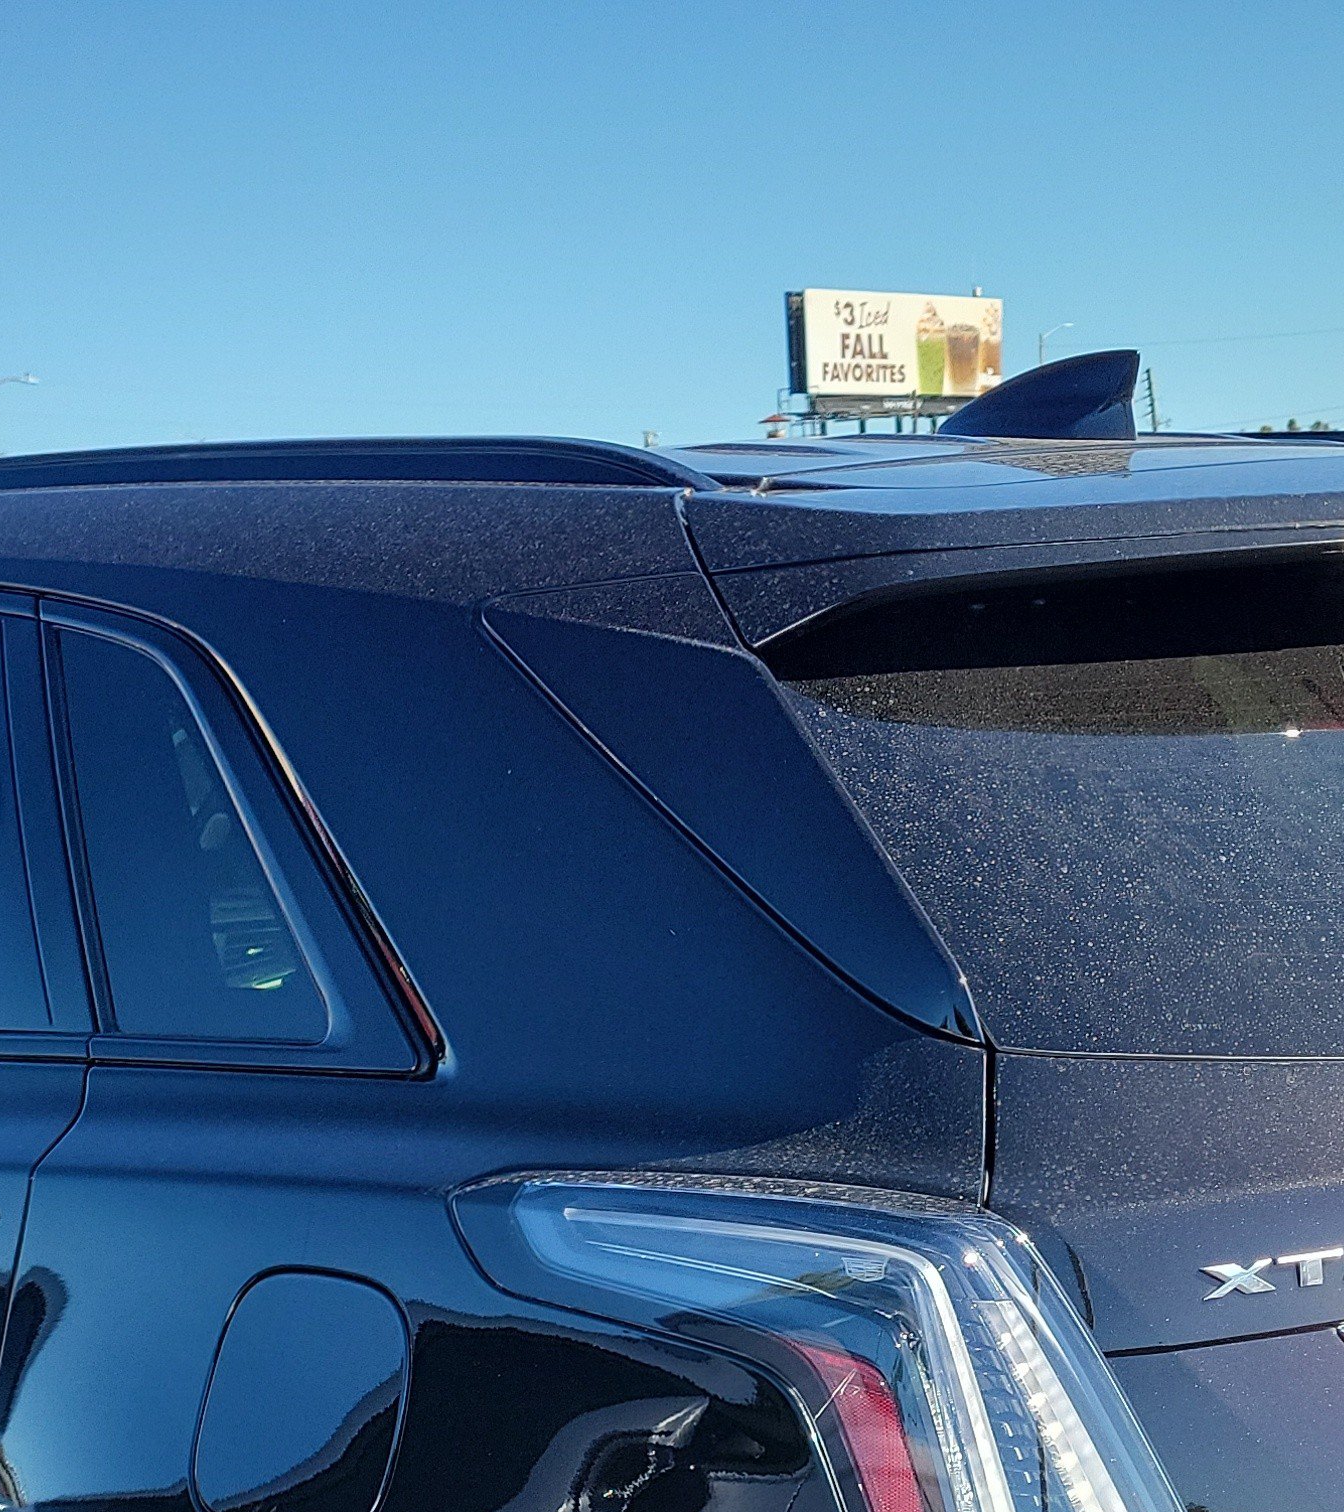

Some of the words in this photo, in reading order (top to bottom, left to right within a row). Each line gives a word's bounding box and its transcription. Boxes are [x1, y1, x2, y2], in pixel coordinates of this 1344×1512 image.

[834, 300, 855, 326] $3
[858, 301, 891, 329] Iced
[841, 333, 888, 359] FALL
[822, 362, 906, 383] FAVORITES
